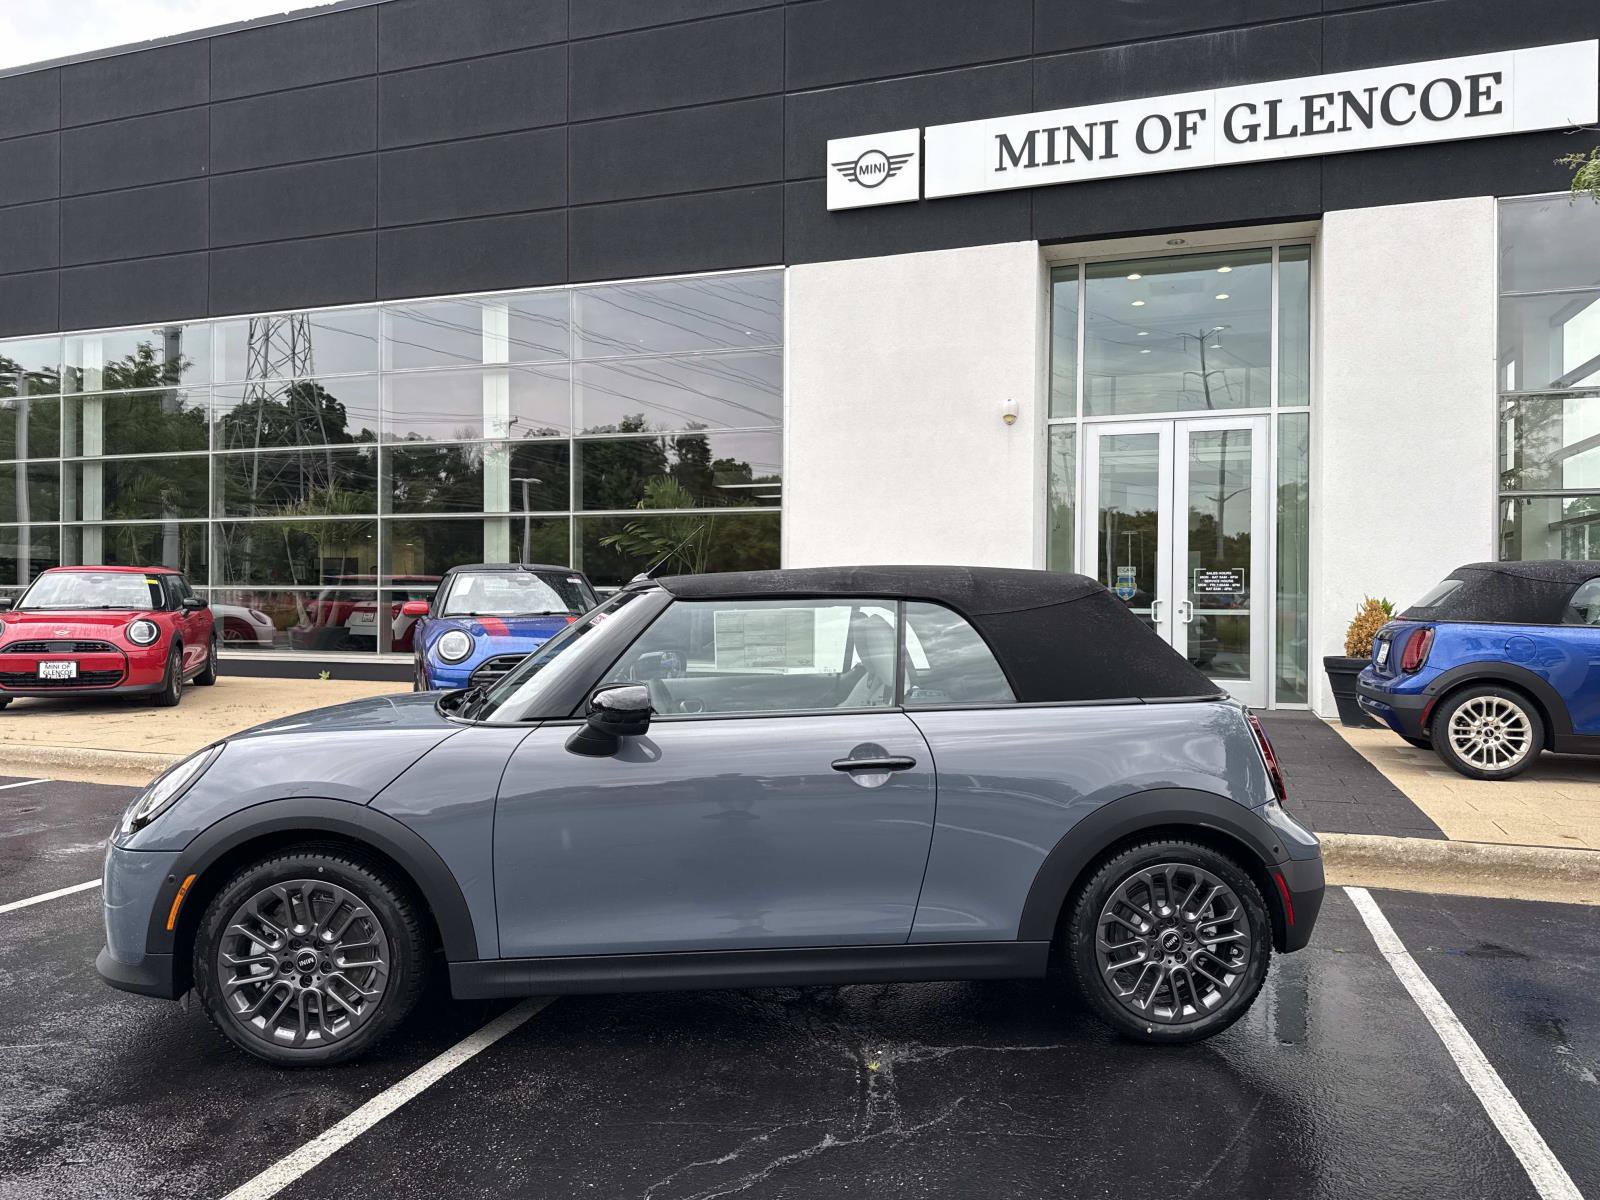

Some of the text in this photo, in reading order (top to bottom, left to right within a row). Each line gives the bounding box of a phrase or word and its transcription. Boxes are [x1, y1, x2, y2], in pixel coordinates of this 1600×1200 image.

[994, 71, 1503, 173] MINI OF GLENCOE
[858, 162, 886, 176] MINI
[298, 957, 315, 967] MINI
